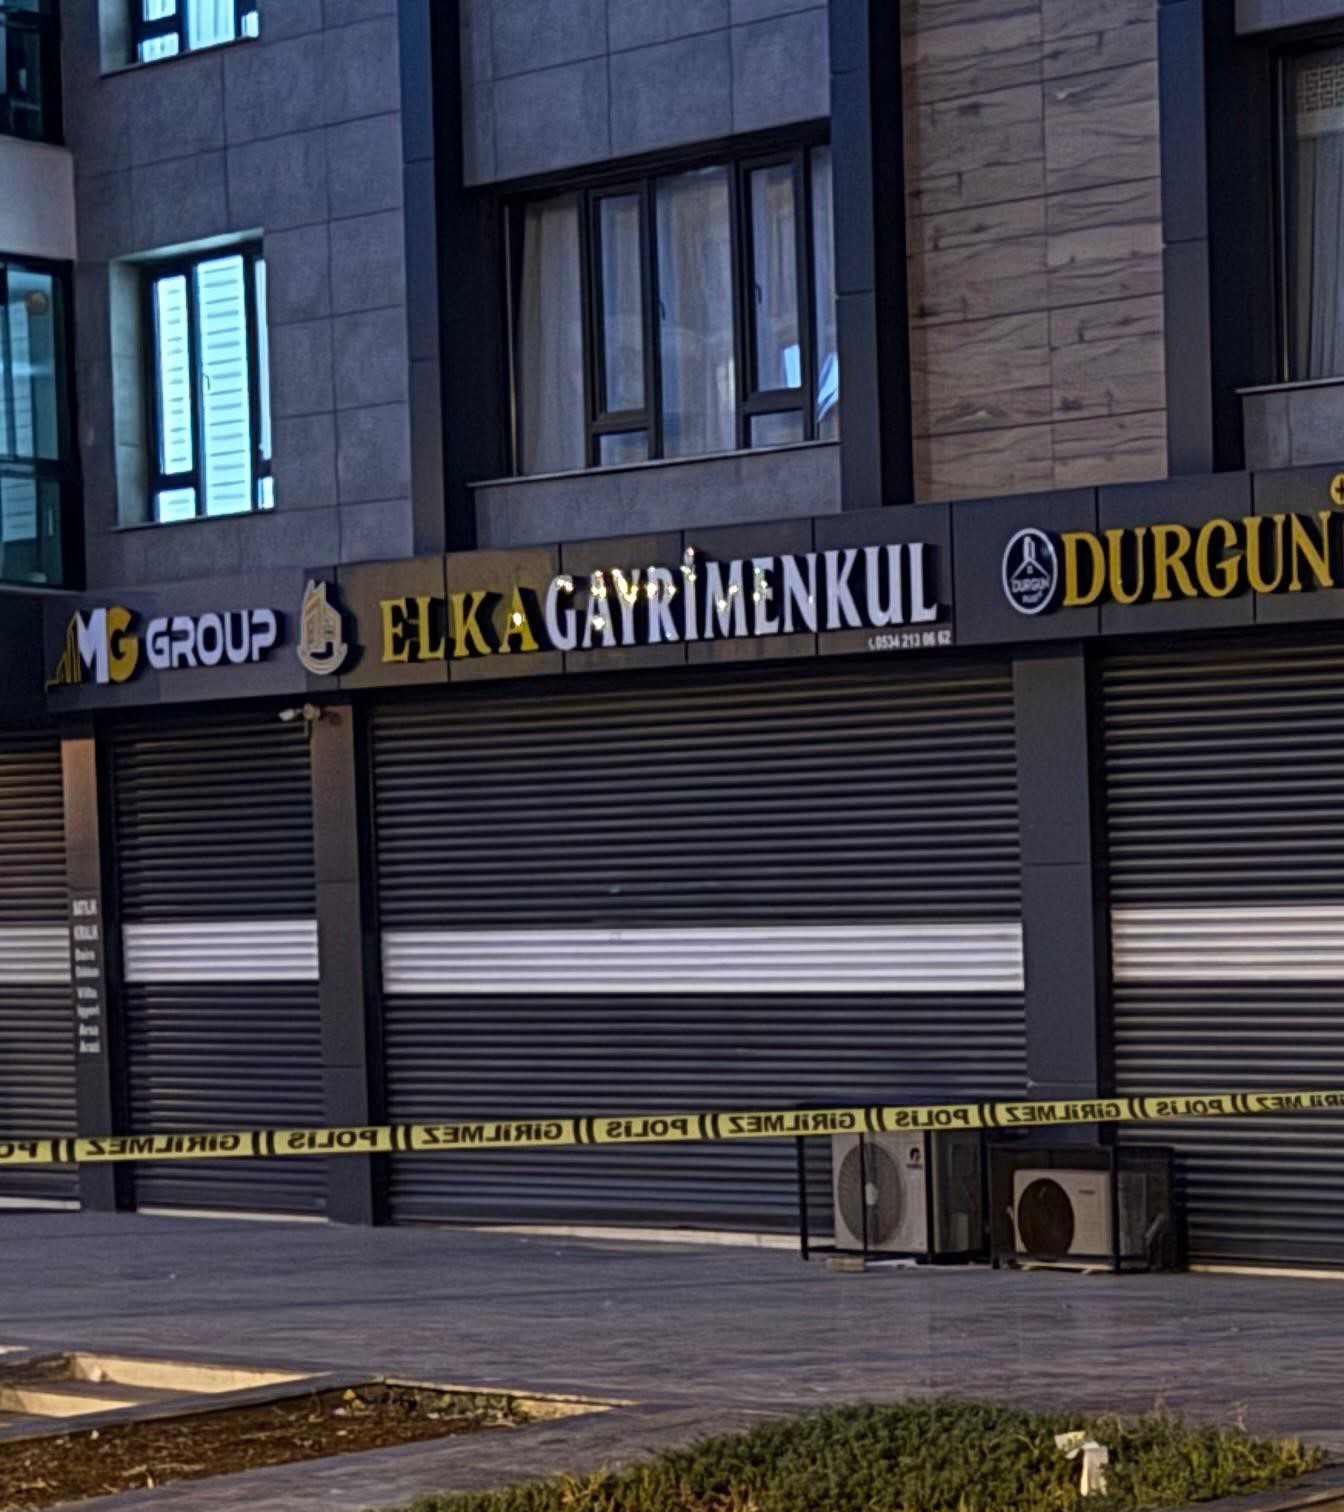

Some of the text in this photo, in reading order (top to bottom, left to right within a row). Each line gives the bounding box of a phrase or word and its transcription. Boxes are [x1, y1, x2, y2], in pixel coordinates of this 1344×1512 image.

[380, 542, 938, 664] ELKA GAYRİMENKUL
[1061, 509, 1334, 607] DURGUN
[76, 606, 277, 684] MG GROUP
